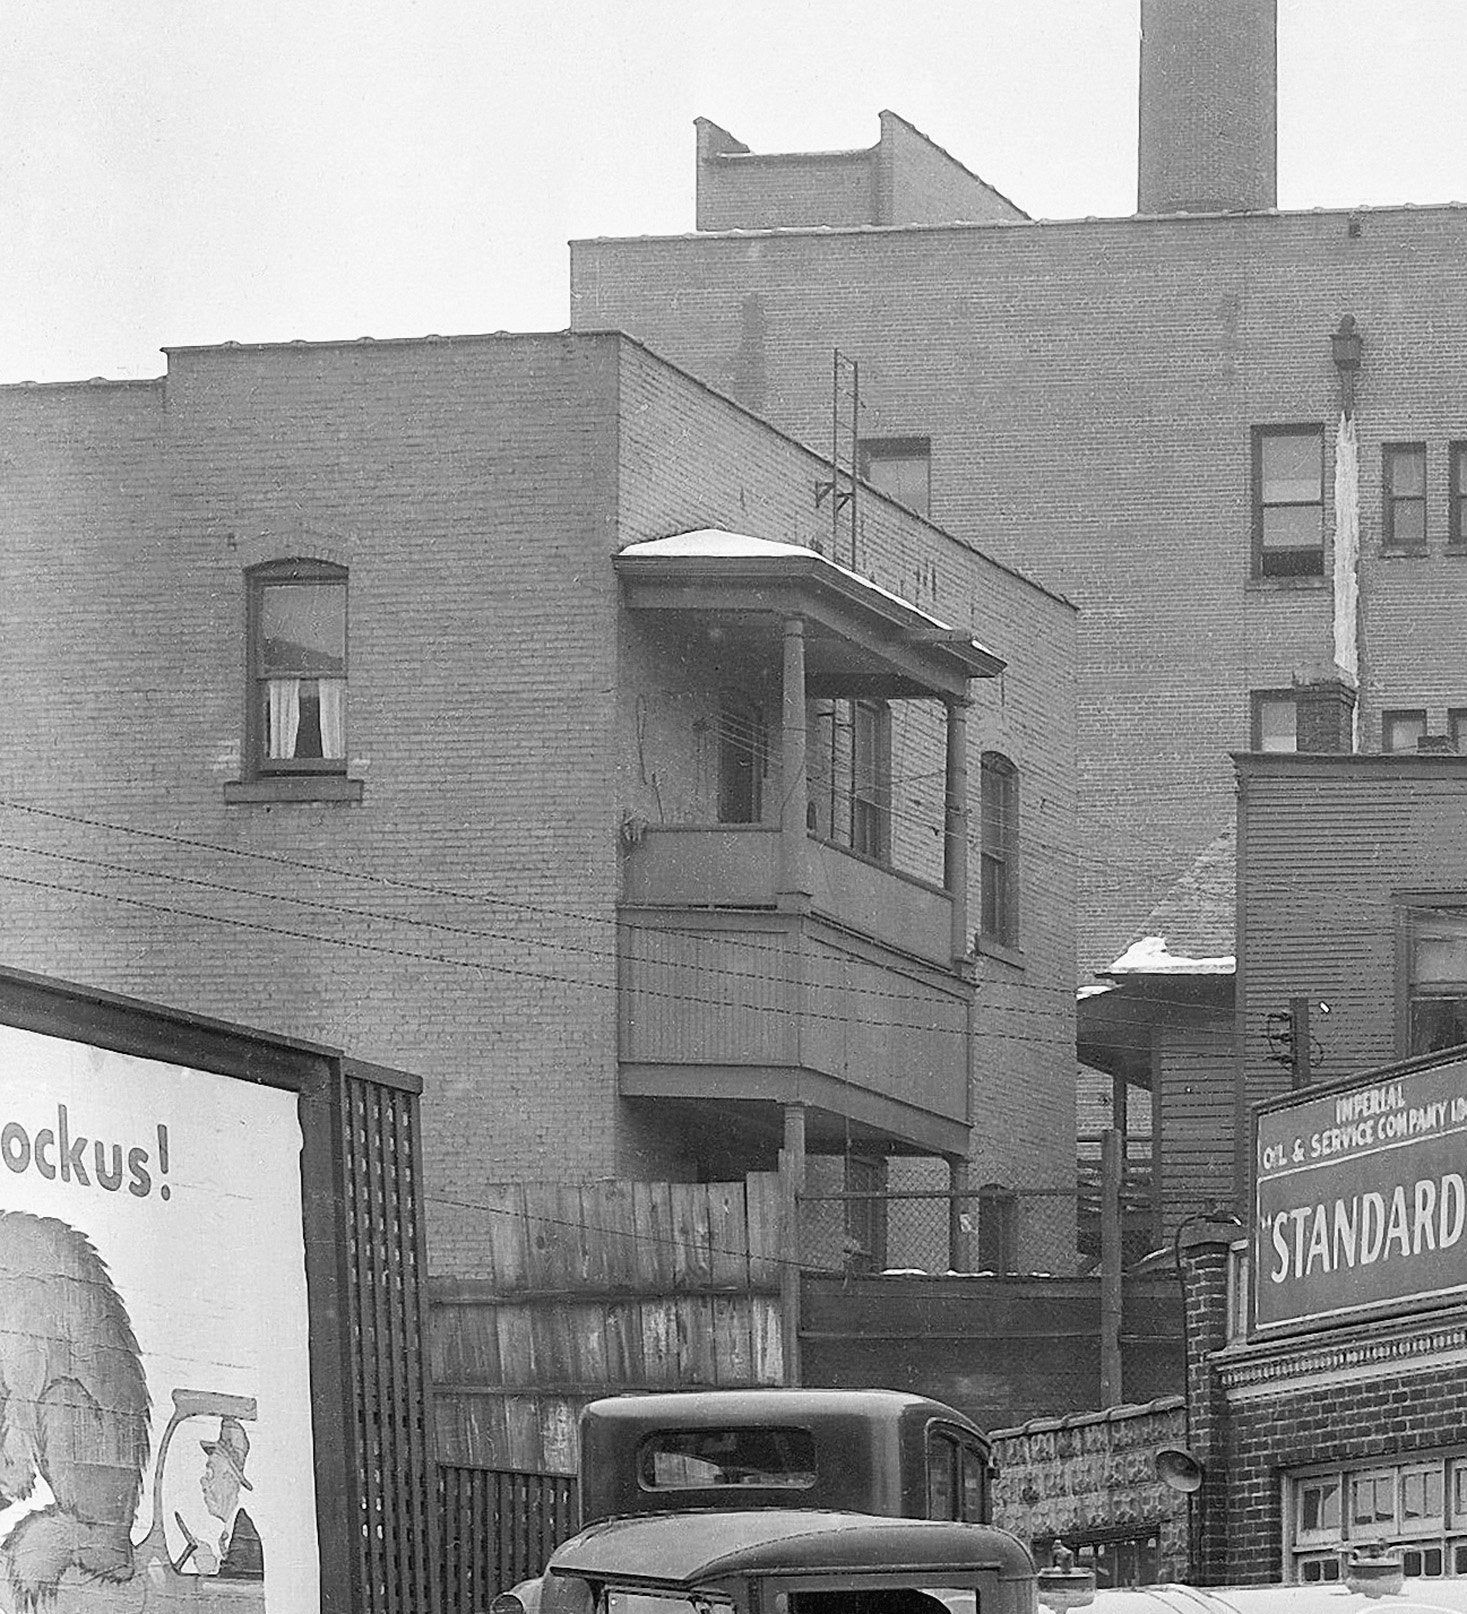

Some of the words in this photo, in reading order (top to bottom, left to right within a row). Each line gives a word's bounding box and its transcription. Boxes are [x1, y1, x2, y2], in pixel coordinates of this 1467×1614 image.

[1335, 1085, 1406, 1124] IMPERIAL
[1262, 1143, 1288, 1170] OIL
[1292, 1138, 1306, 1162] &
[1310, 1118, 1375, 1158] SERVICE
[1377, 1099, 1450, 1141] COMPANY
